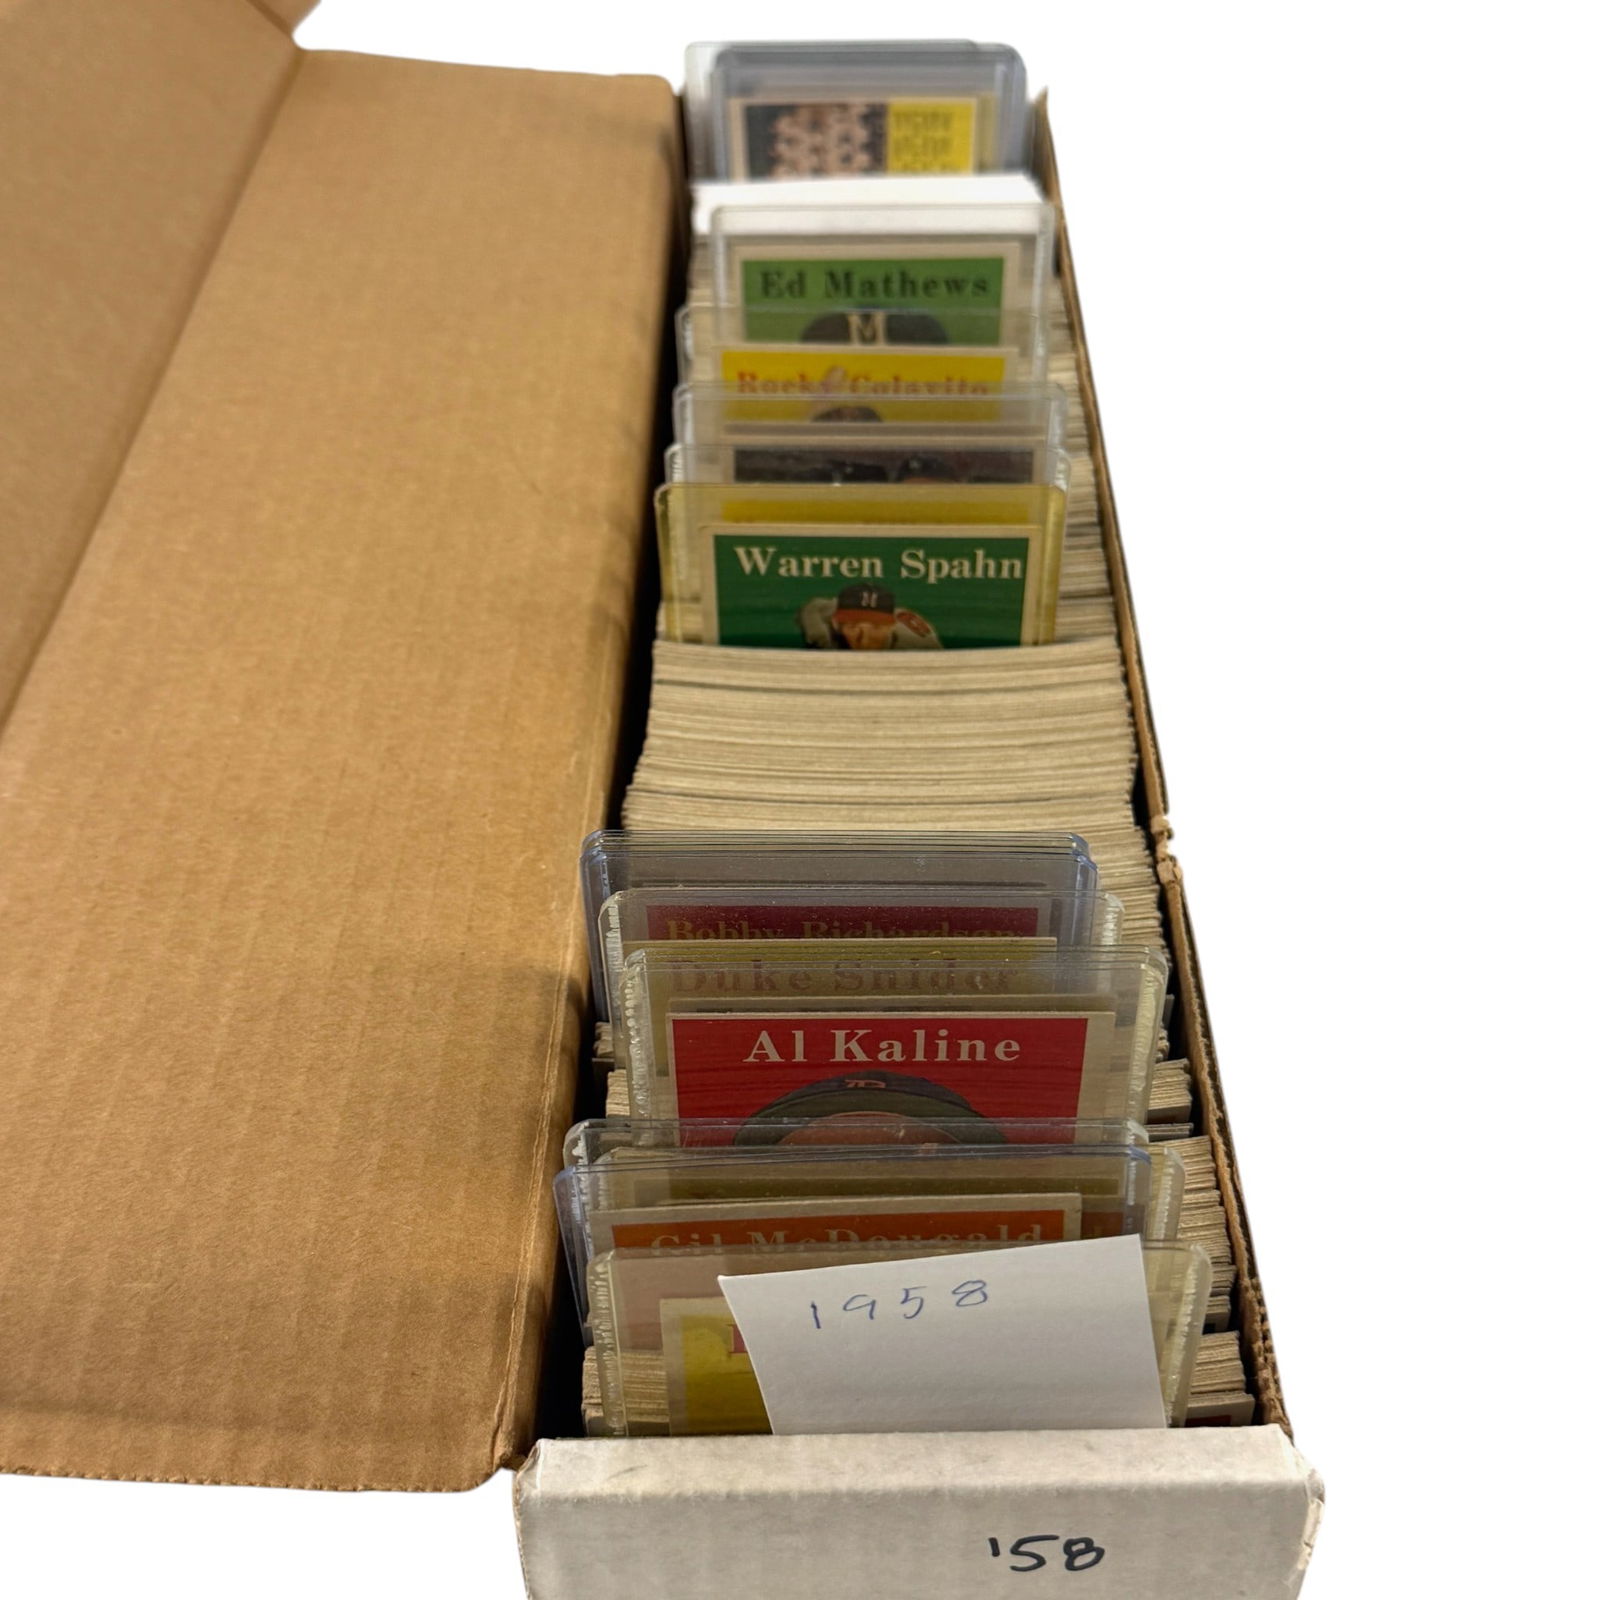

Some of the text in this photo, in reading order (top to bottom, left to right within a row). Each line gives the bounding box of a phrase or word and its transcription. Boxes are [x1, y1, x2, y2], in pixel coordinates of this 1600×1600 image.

[760, 269, 989, 299] Ed Mathews
[734, 546, 1023, 584] Warren Spahn
[671, 957, 1017, 993] Duke Snider
[743, 1029, 1021, 1064] Al Kaline
[809, 1279, 989, 1330] 1958
